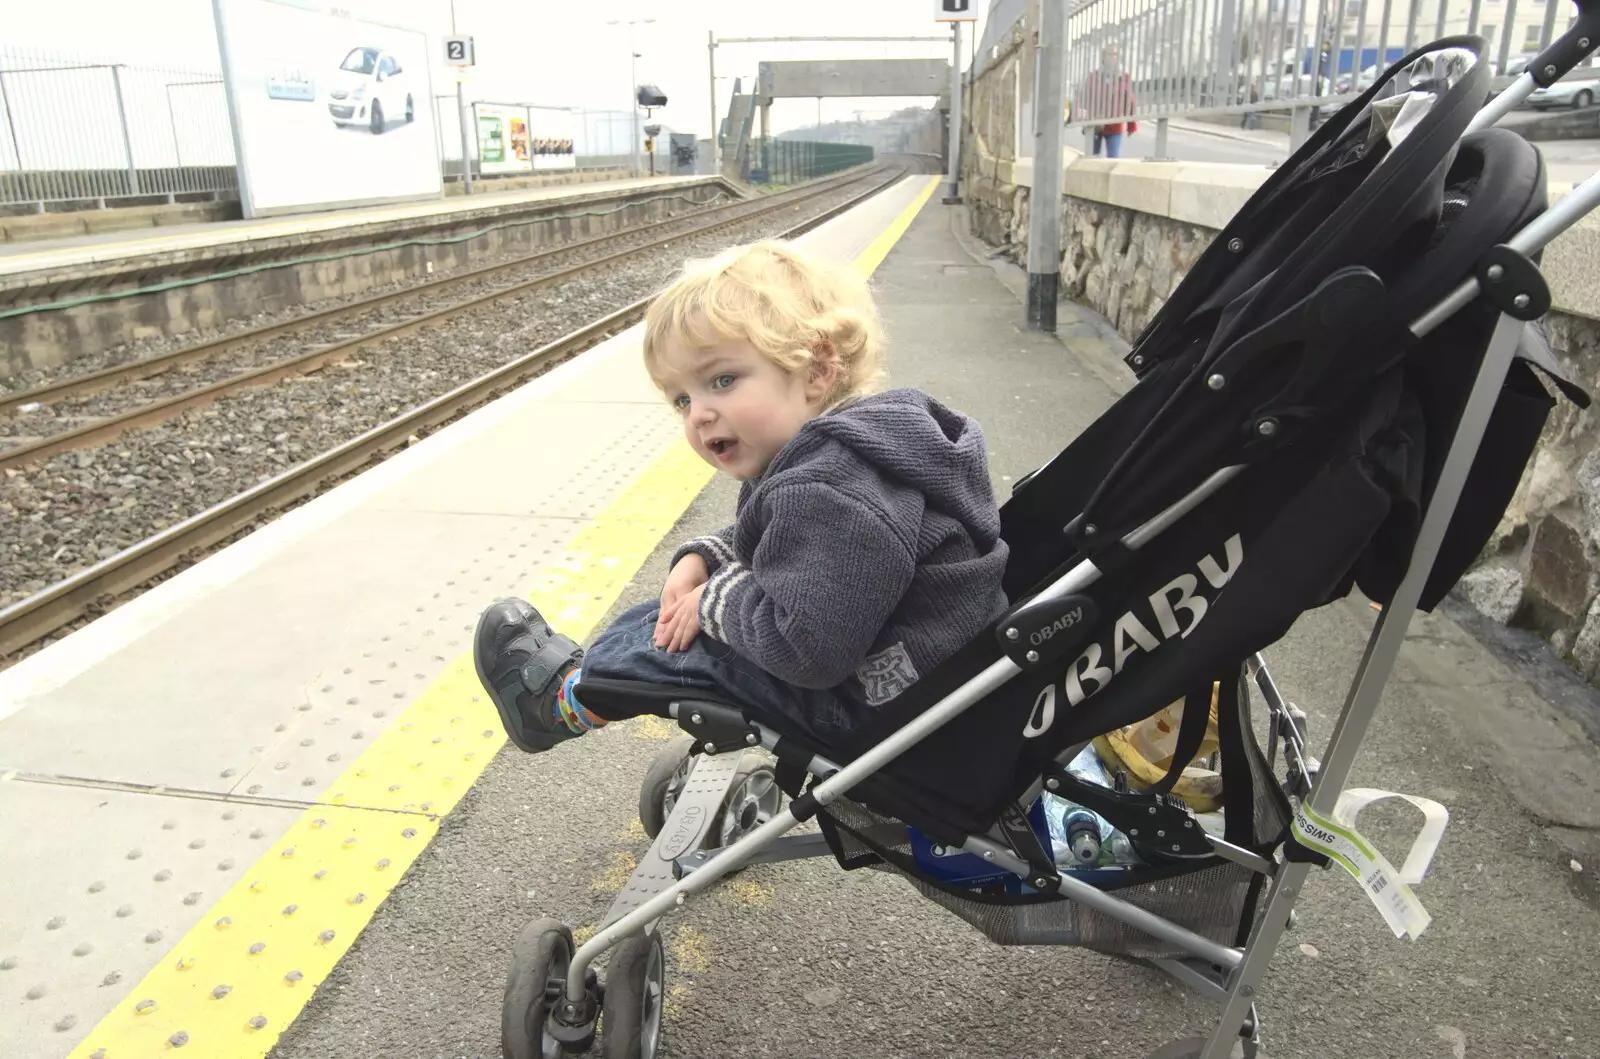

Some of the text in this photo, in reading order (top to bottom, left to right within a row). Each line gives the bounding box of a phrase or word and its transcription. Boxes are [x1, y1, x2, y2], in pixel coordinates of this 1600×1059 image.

[450, 42, 462, 58] 2
[1022, 532, 1244, 738] OBABY
[1030, 606, 1083, 646] OBABY
[665, 806, 702, 853] OBABY
[1296, 813, 1336, 844] SWISSP
